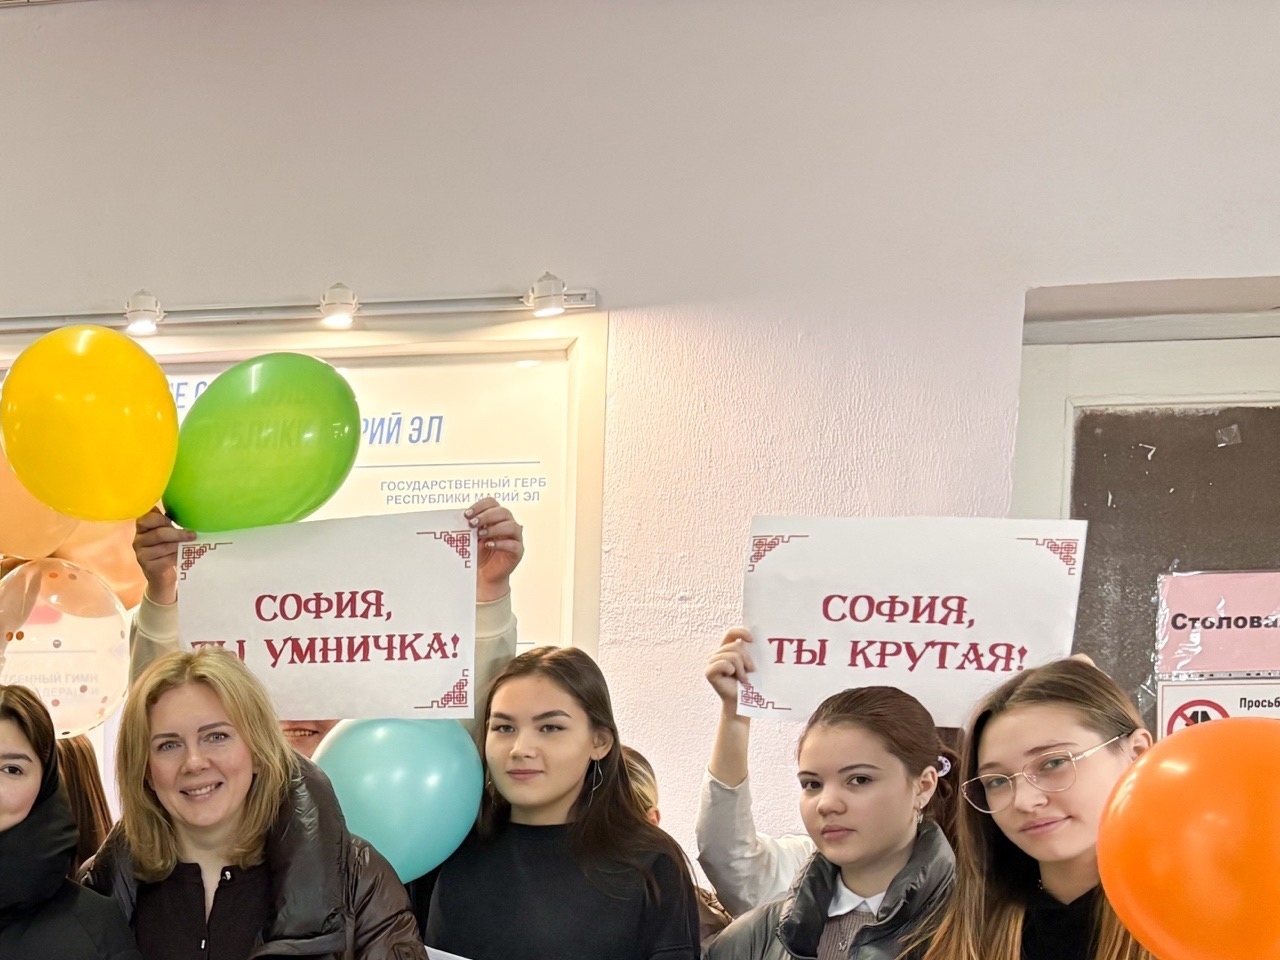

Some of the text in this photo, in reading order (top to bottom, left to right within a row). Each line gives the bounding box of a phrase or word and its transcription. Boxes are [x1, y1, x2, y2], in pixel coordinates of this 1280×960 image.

[408, 415, 444, 443] ЭЛ
[380, 476, 547, 492] ГОСУДАРСТВЕННЫЙ ГЕРБ
[386, 493, 470, 505] РЕСПУБЛИКИ
[523, 491, 540, 501] ЭЛ
[255, 589, 392, 622] СОФИЯ,
[822, 594, 975, 629] СОФИЯ,
[1171, 613, 1280, 630] Столова
[264, 632, 461, 668] УМНИЧКА!
[767, 637, 1028, 672] ТЫ КРУТАЯ!
[1239, 697, 1280, 711] Просьб
